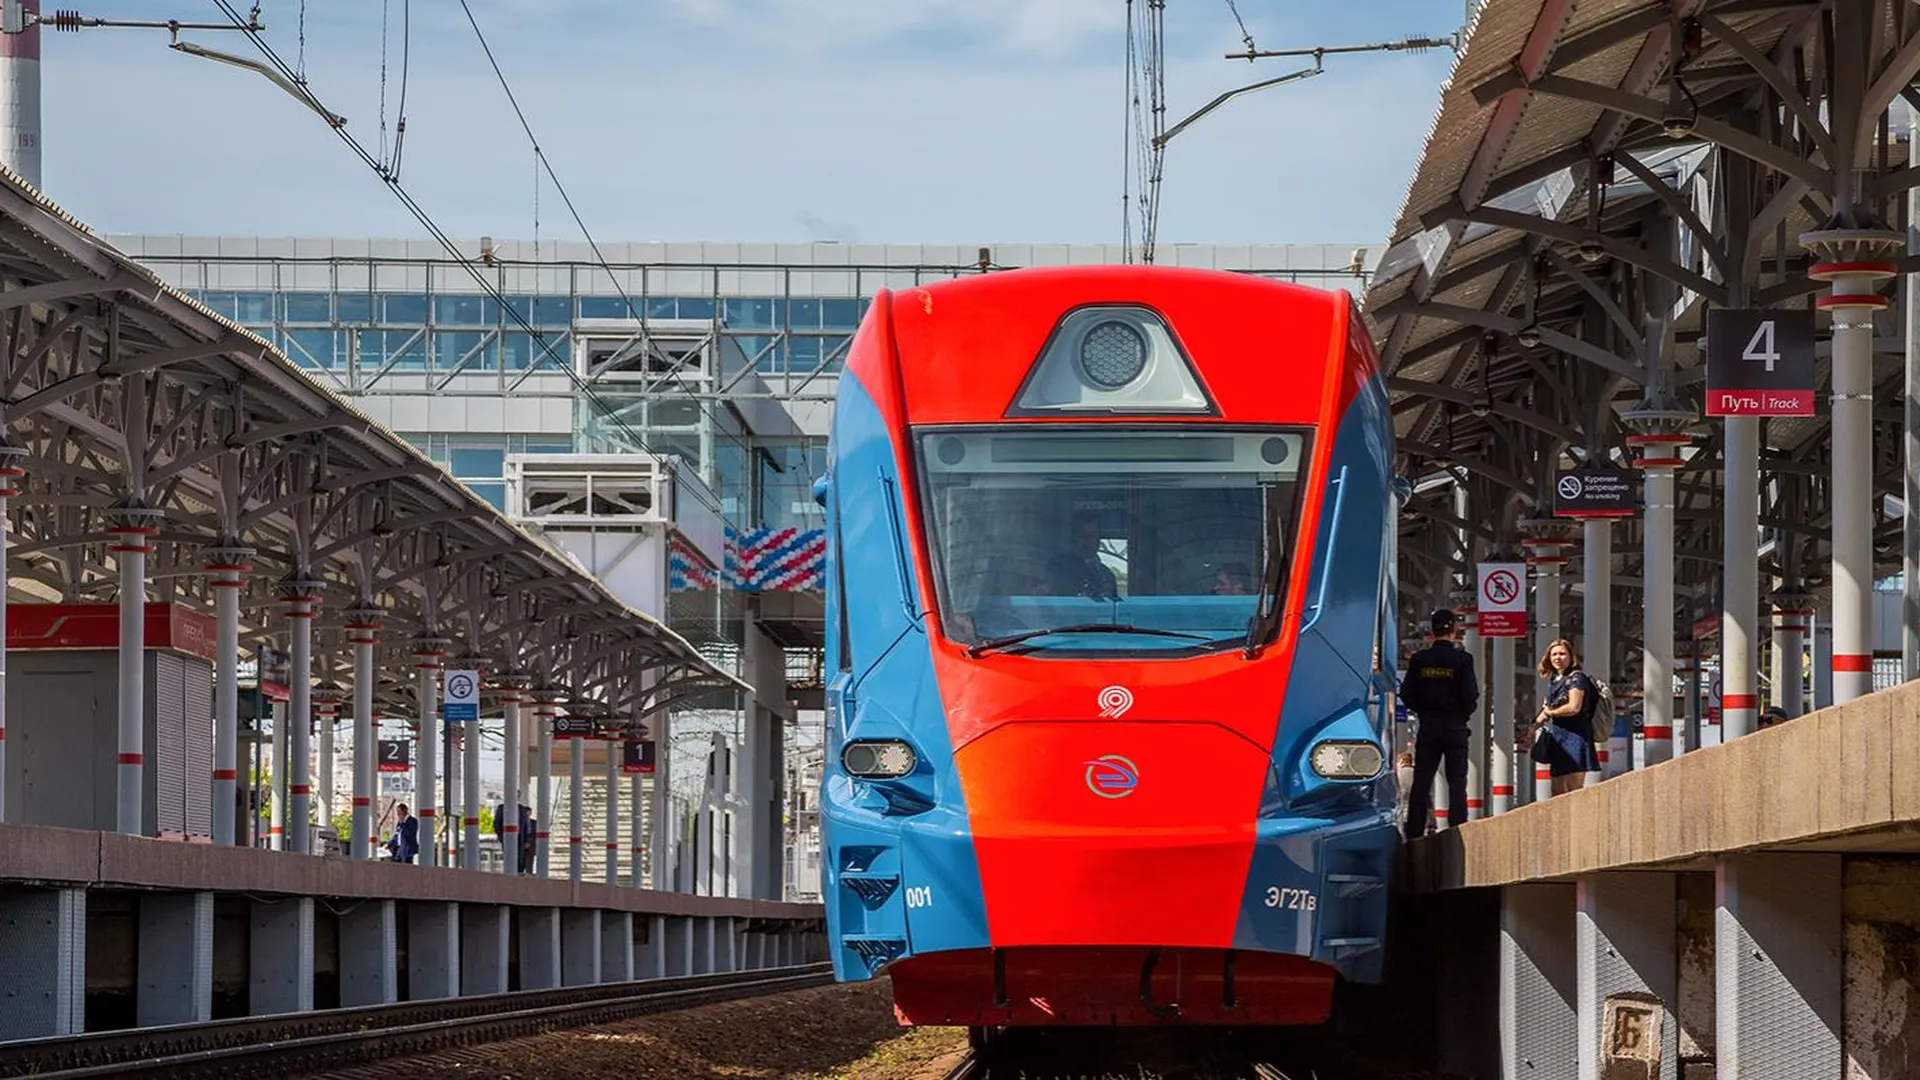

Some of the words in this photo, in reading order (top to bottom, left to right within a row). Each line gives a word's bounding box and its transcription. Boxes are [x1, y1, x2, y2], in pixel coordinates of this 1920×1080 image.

[1742, 320, 1781, 372] 4
[1721, 394, 1759, 412] Путь
[1768, 397, 1799, 408] Track
[1584, 475, 1618, 484] Курение
[387, 742, 399, 760] 2
[635, 743, 643, 760] 1
[906, 886, 932, 909] 001
[1264, 886, 1317, 911] ЭГ2Тв
